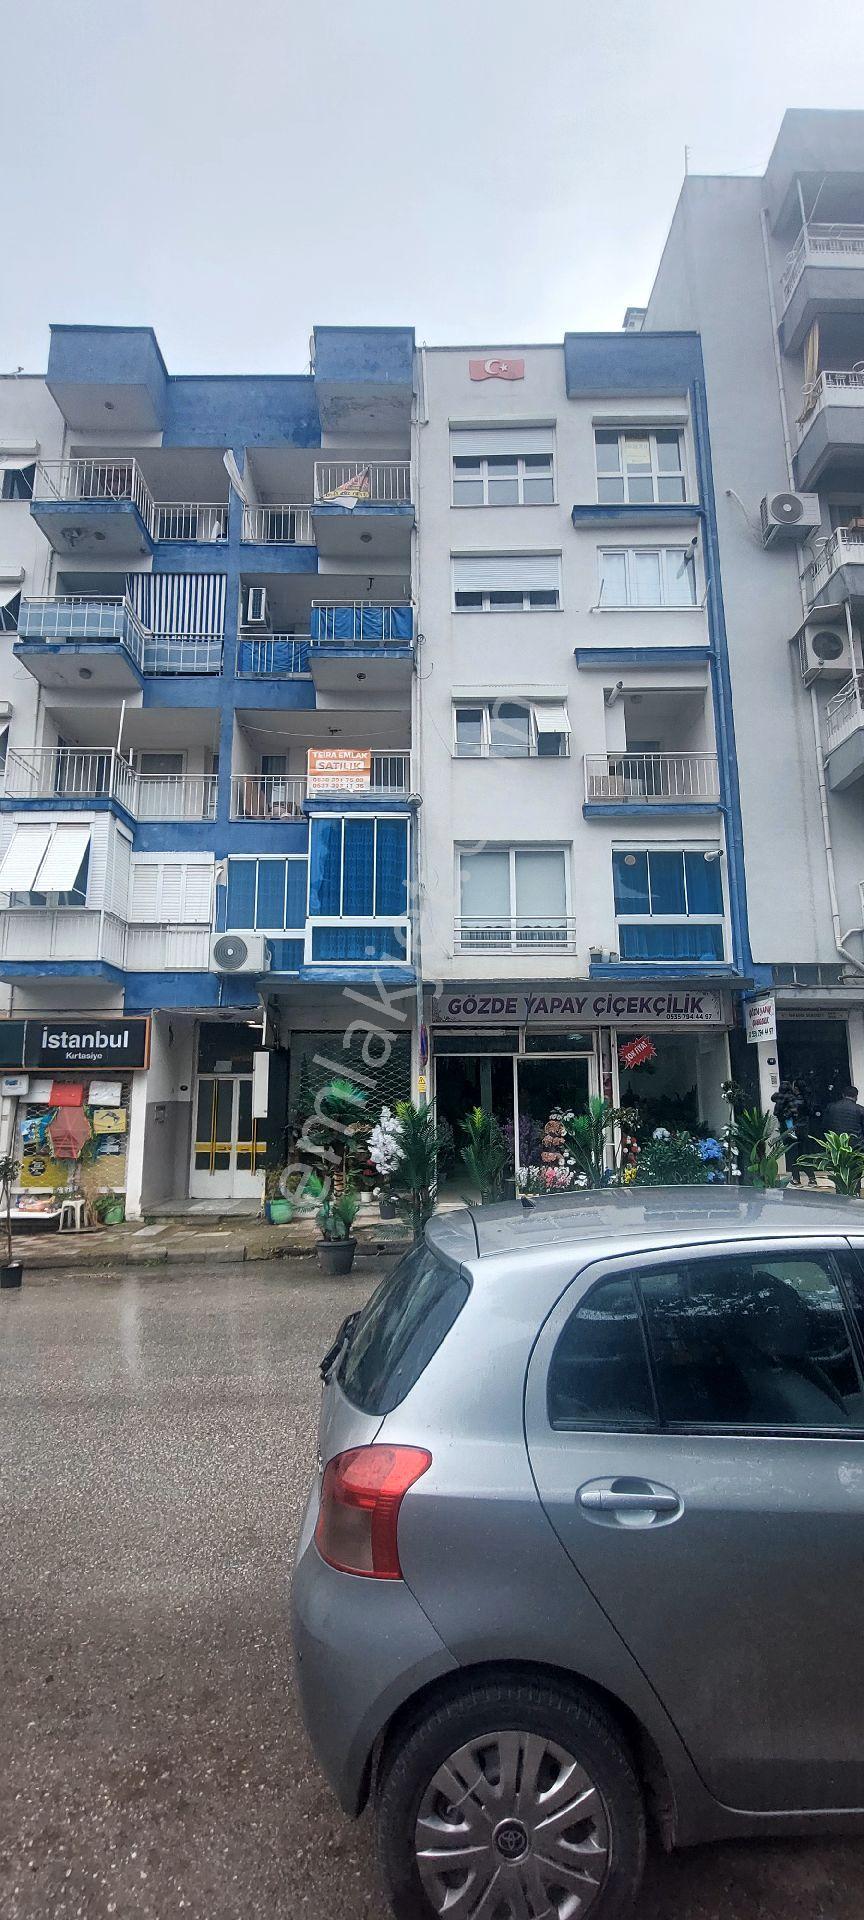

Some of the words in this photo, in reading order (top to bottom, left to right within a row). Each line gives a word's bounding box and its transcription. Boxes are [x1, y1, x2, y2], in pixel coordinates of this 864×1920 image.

[339, 751, 368, 759] EMLAK
[318, 762, 361, 770] SATILIK
[448, 994, 518, 1014] GÖZDE
[523, 996, 588, 1014] YAPAY
[592, 993, 704, 1017] ÇİÇEKÇİLİK
[41, 1026, 129, 1049] İstanbul
